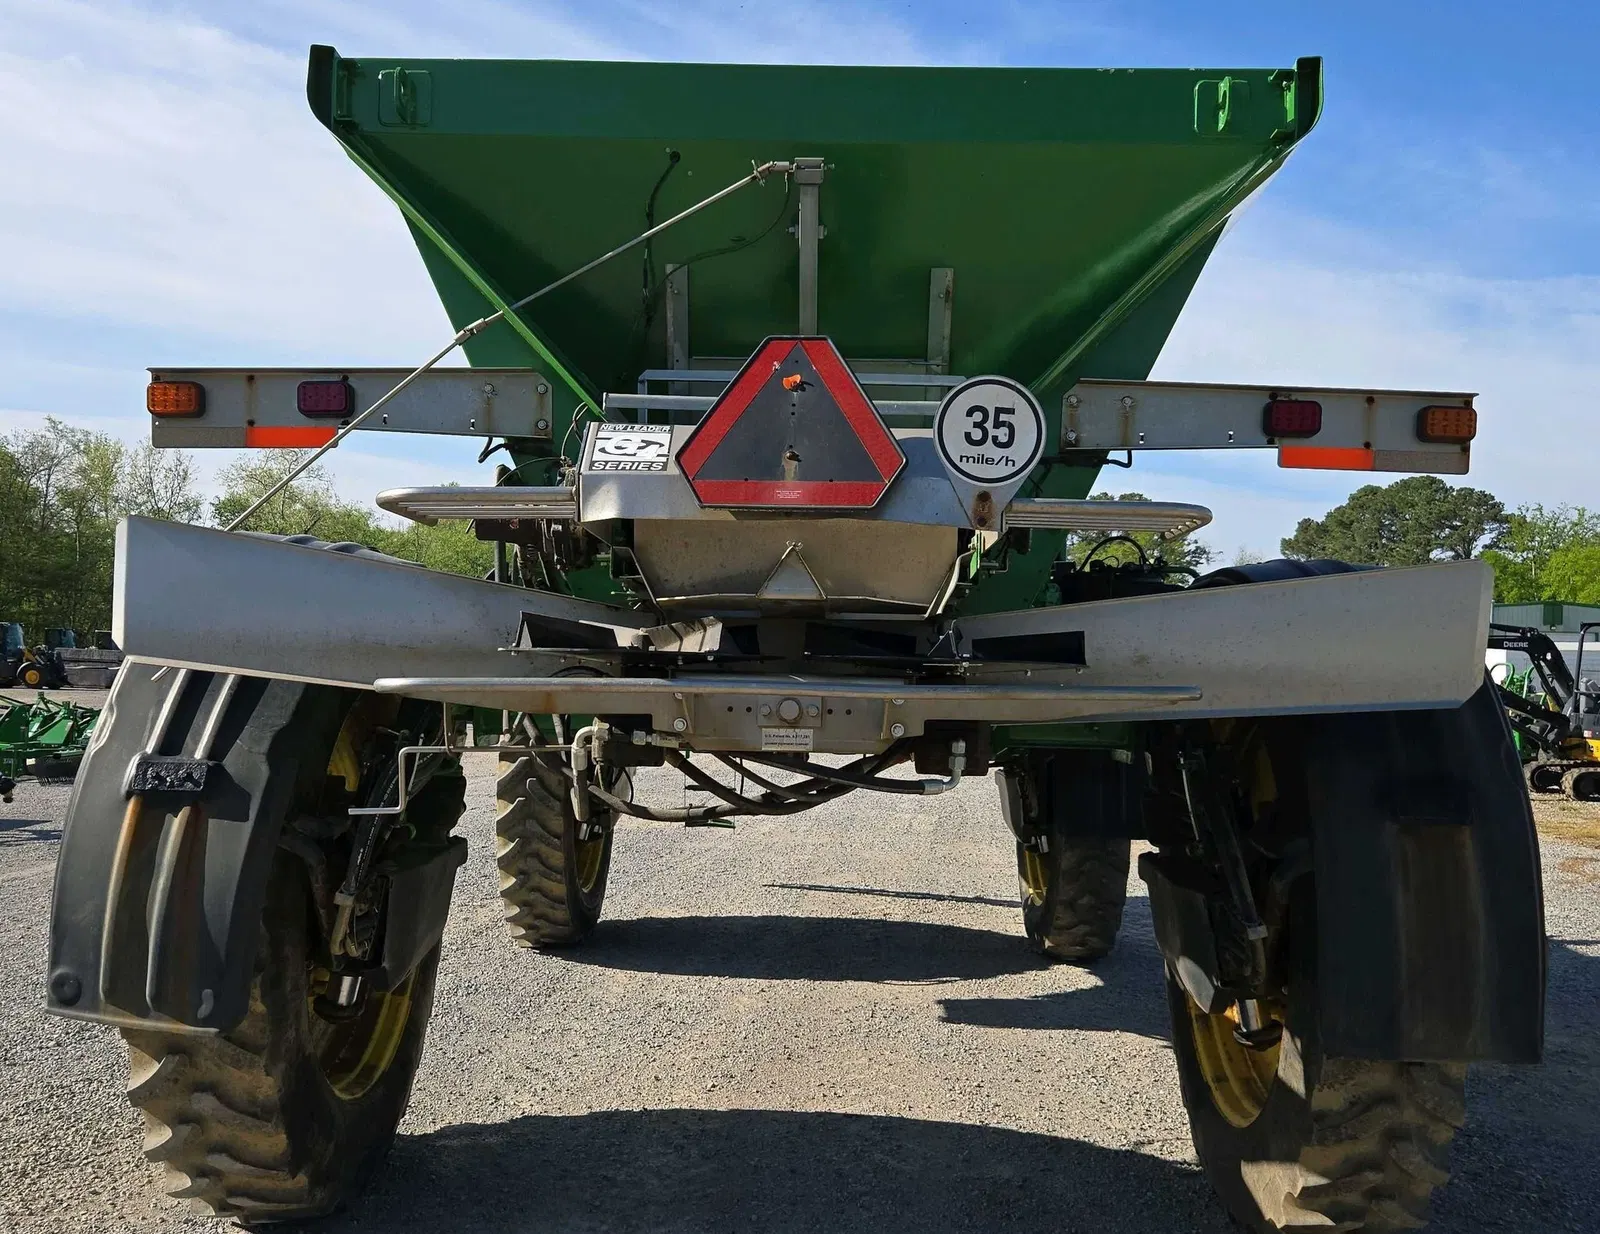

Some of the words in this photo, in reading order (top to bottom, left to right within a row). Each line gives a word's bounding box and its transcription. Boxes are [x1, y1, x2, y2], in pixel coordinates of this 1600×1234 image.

[600, 423, 625, 432] NEW
[626, 424, 671, 432] LEADER
[964, 404, 1016, 450] 35
[592, 461, 664, 471] SERIES
[959, 453, 1016, 468] mile/h
